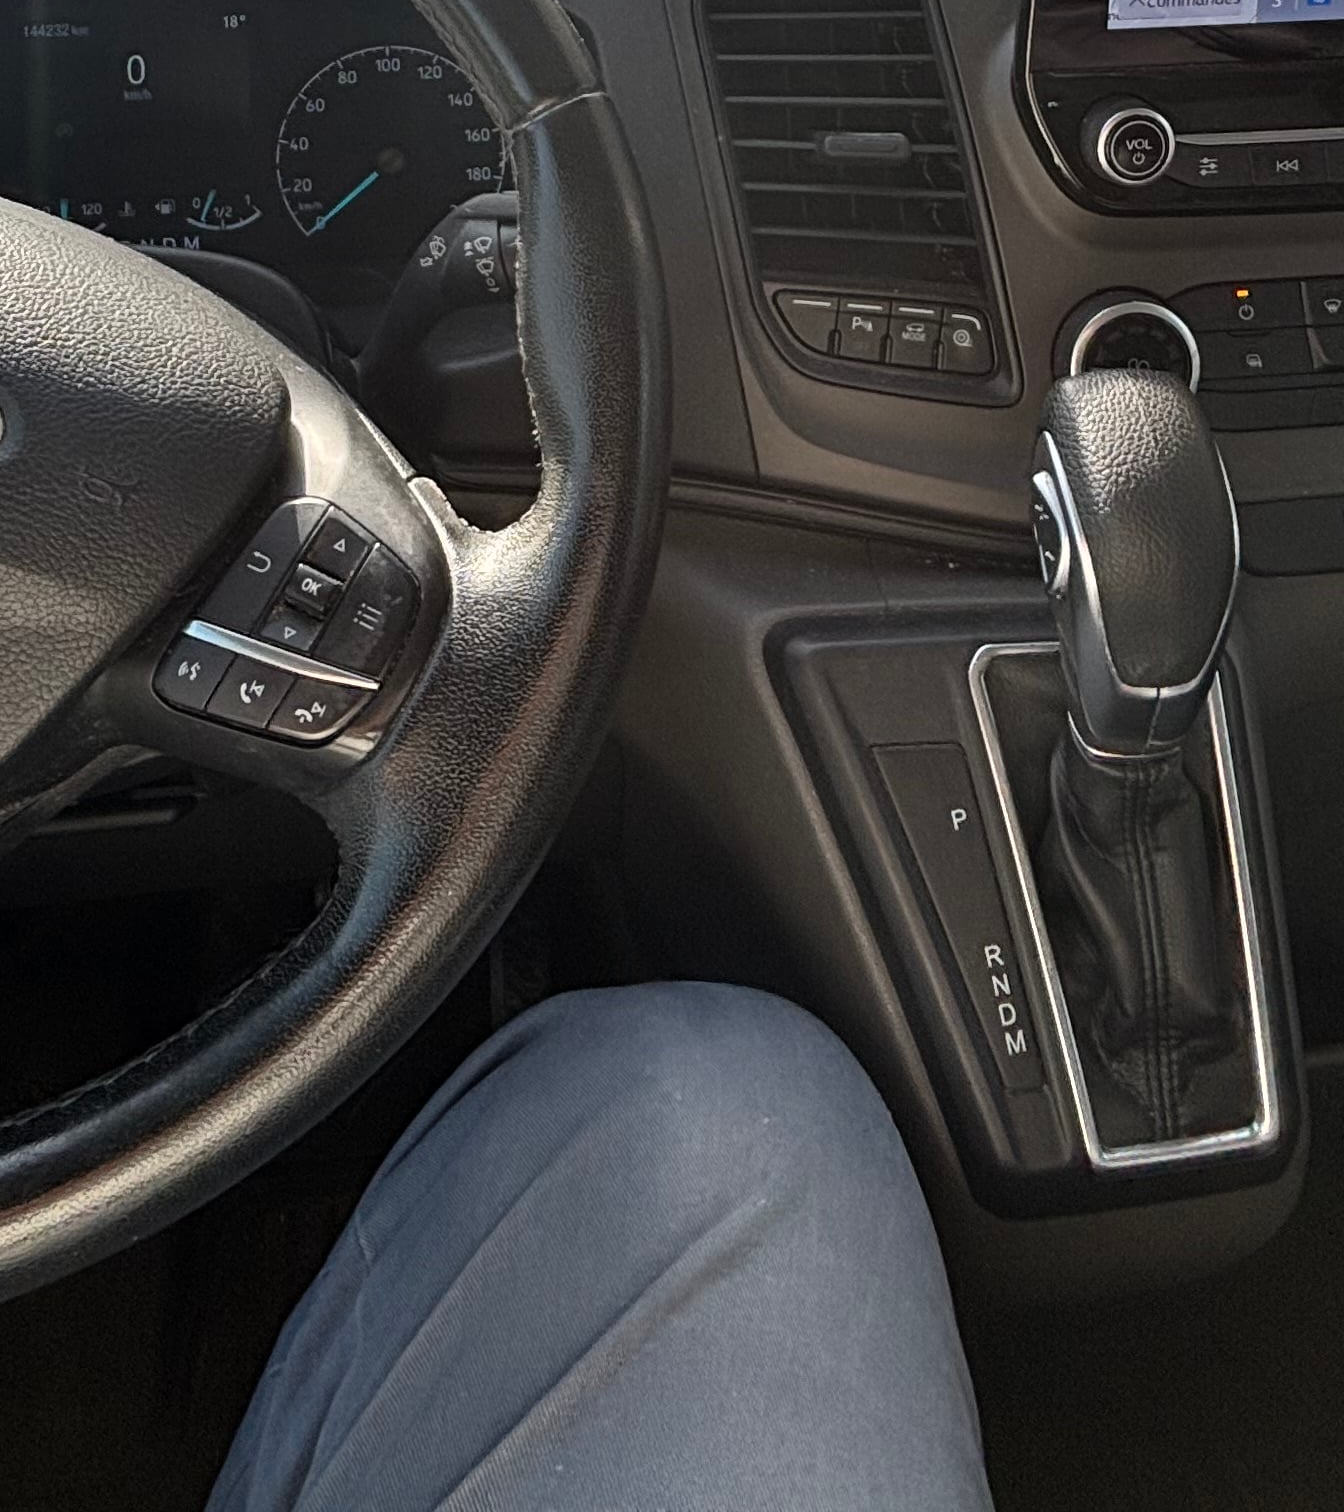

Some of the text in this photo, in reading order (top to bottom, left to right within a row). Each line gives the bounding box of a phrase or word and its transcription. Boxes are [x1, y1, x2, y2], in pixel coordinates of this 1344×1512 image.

[126, 55, 146, 85] 0
[375, 58, 401, 73] 100
[417, 65, 443, 80] 120
[337, 70, 357, 85] 80
[305, 98, 325, 113] 60
[447, 92, 474, 108] 140
[464, 128, 491, 143] 160
[289, 136, 309, 151] 40
[1125, 139, 1153, 151] VOL
[465, 166, 492, 182] 180
[293, 178, 312, 193] 20
[81, 202, 103, 216] 120
[192, 198, 201, 210] 0
[213, 206, 233, 219] 1/2
[902, 331, 927, 343] MODE
[301, 578, 322, 597] OK
[951, 809, 967, 831] P
[984, 944, 1005, 968] R
[992, 973, 1011, 997] N
[998, 1003, 1017, 1027] D
[1005, 1029, 1028, 1056] M
